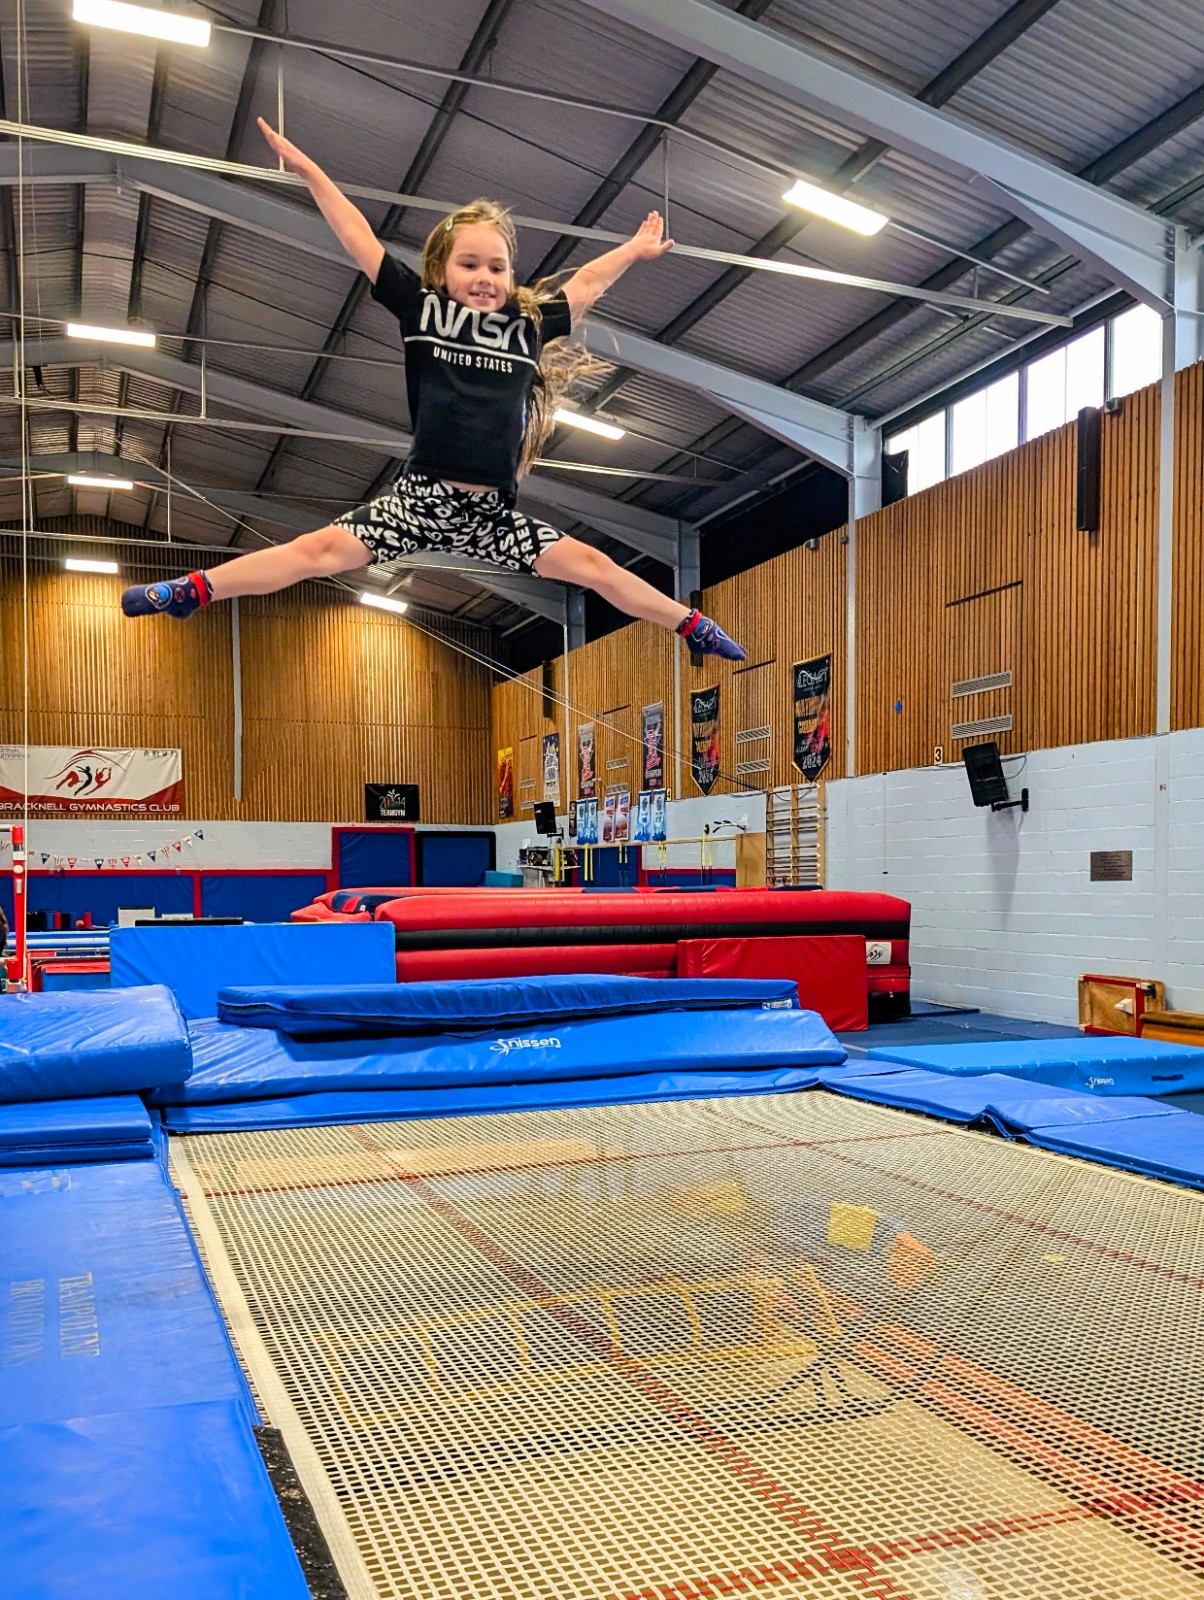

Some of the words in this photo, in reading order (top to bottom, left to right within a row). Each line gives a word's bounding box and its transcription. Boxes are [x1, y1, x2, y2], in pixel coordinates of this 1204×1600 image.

[419, 293, 529, 356] NASA
[433, 346, 472, 367] UNITED
[475, 356, 513, 374] STATES
[935, 748, 942, 763] 3
[0, 802, 67, 811] BRACKNELL
[69, 803, 147, 812] GYMNASTICS
[149, 804, 180, 812] CLUB
